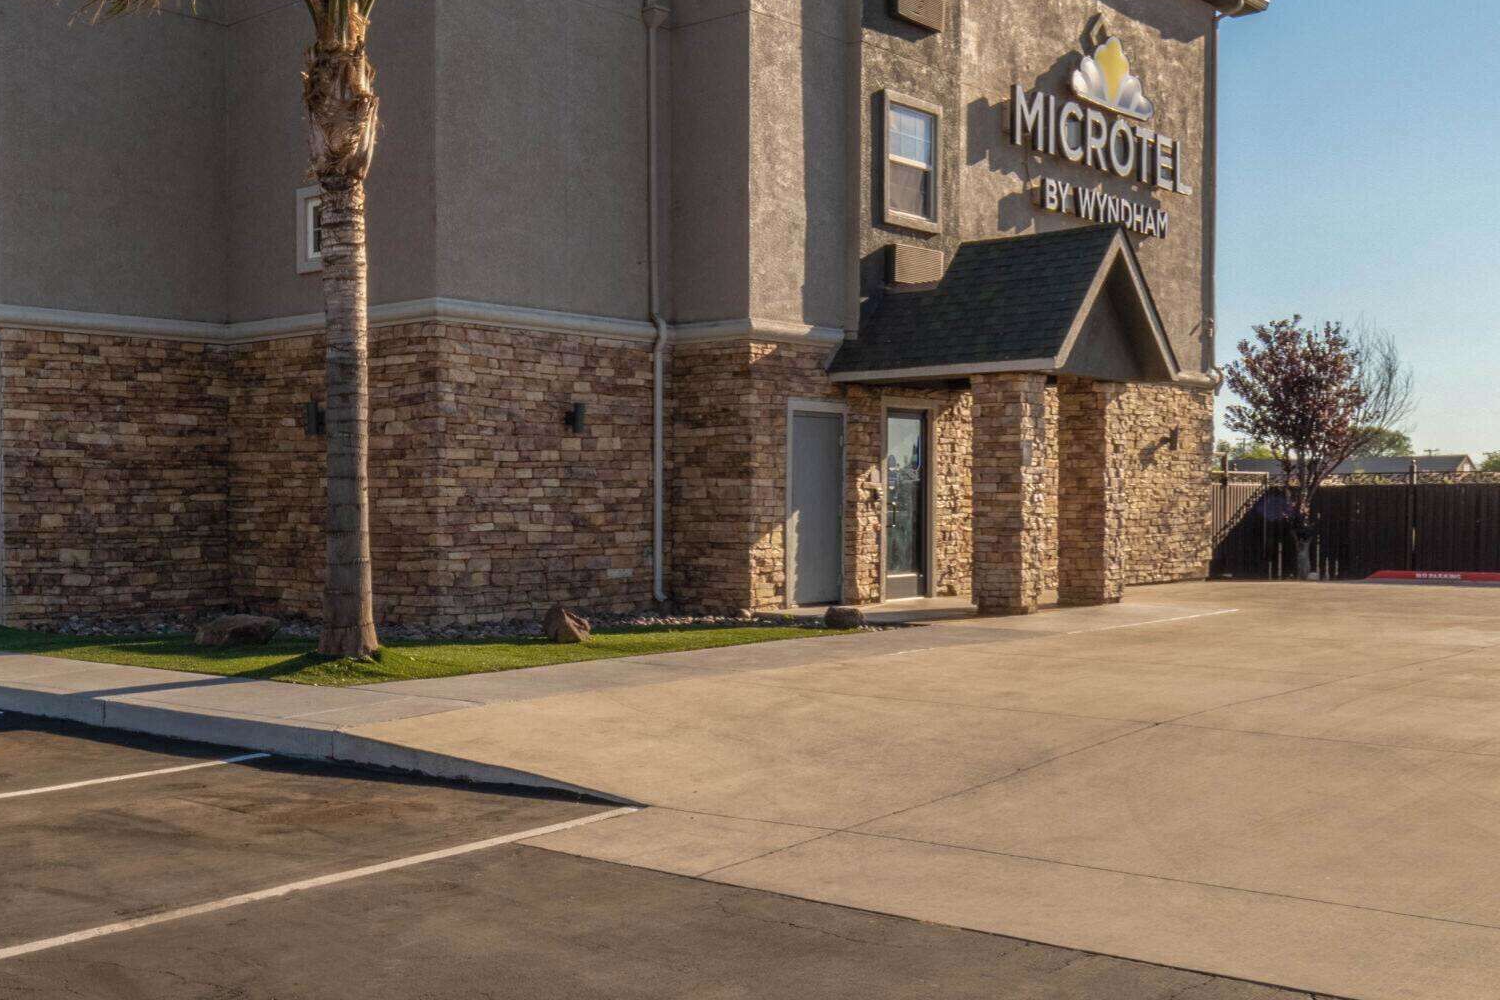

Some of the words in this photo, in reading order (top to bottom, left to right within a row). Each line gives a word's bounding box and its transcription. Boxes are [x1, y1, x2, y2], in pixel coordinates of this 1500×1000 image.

[1013, 84, 1193, 196] MICROTEL
[1044, 177, 1070, 214] BY
[1078, 186, 1169, 240] WYNDHAM
